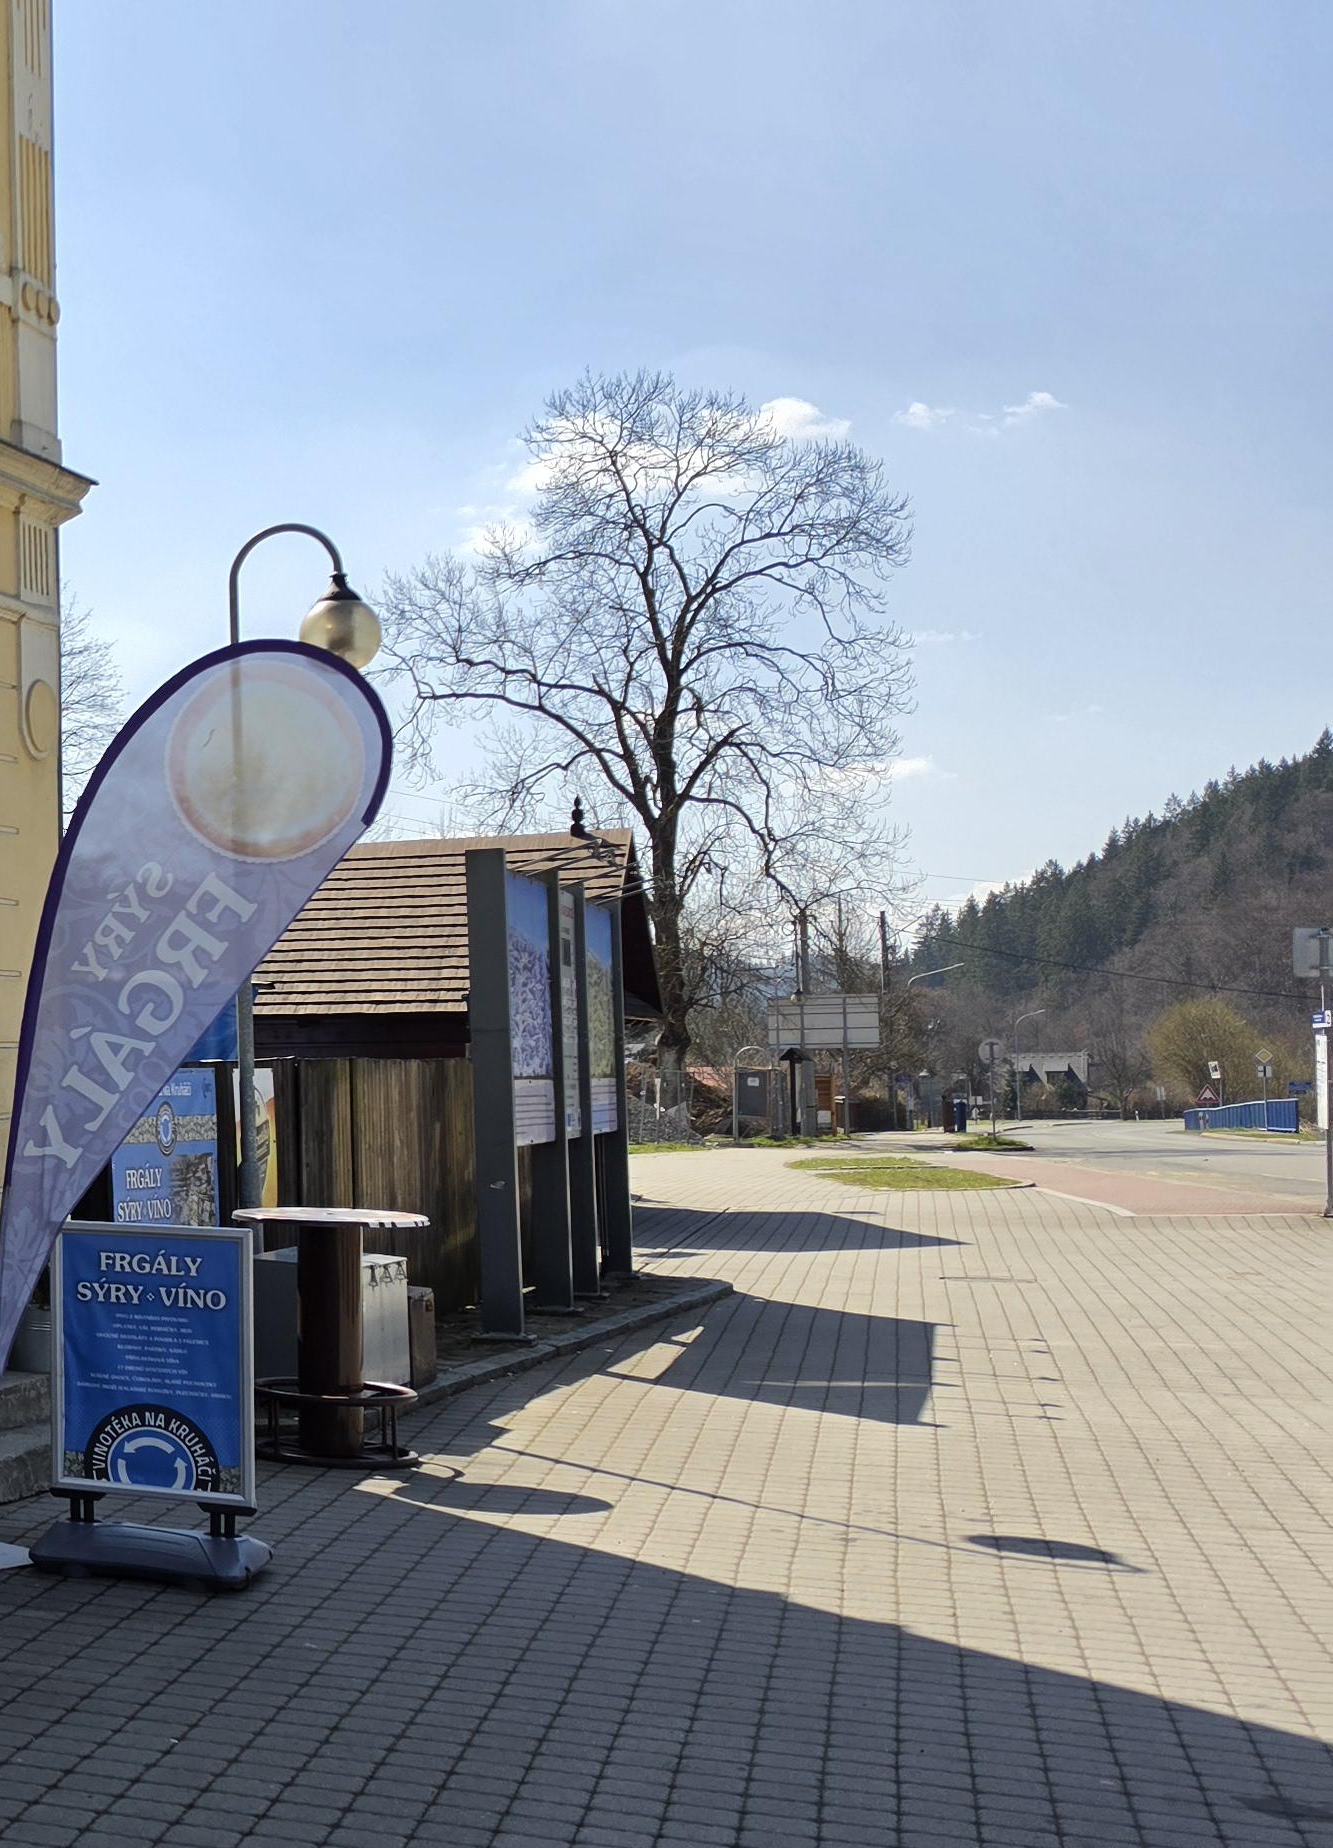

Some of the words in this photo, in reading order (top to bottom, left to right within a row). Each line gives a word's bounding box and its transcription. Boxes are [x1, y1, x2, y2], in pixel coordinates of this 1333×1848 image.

[126, 1164, 162, 1189] FRGÁLY
[118, 1197, 143, 1221] SÝRY
[147, 1196, 171, 1219] VÍNO
[99, 1249, 203, 1277] FRGÁLY
[77, 1278, 143, 1305] SÝRY
[159, 1282, 227, 1310] VÍNO
[92, 1411, 141, 1470] VINOTÉKA
[145, 1411, 167, 1428] NA
[170, 1418, 216, 1481] KRUHÁČI
